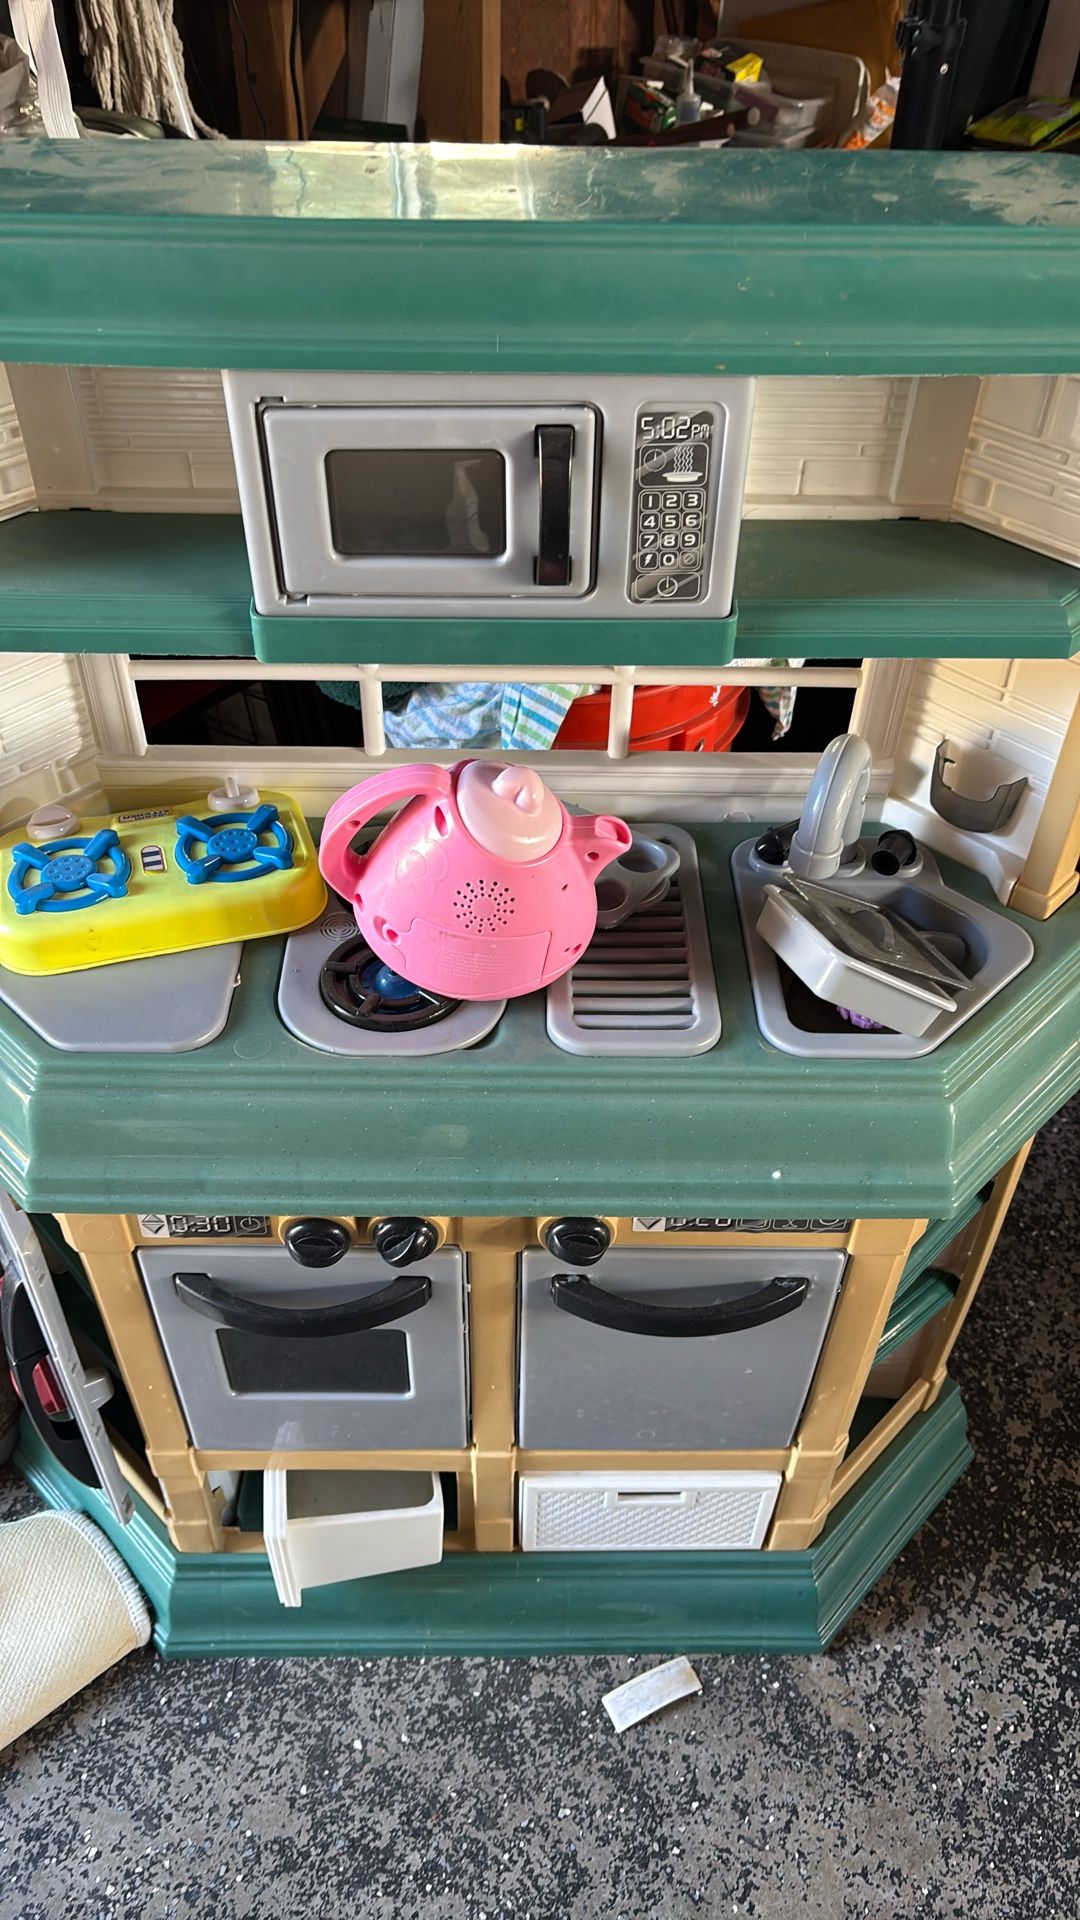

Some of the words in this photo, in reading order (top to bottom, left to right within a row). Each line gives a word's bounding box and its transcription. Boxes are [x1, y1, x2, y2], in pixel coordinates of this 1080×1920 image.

[648, 495, 653, 508] 1
[665, 494, 678, 507] 2
[687, 493, 699, 507] 3
[643, 515, 656, 528] 4
[664, 514, 677, 527] 5
[685, 514, 698, 527] 6
[643, 534, 656, 548] 7
[663, 534, 676, 547] 8
[683, 533, 696, 546] 9
[662, 553, 675, 566] 0
